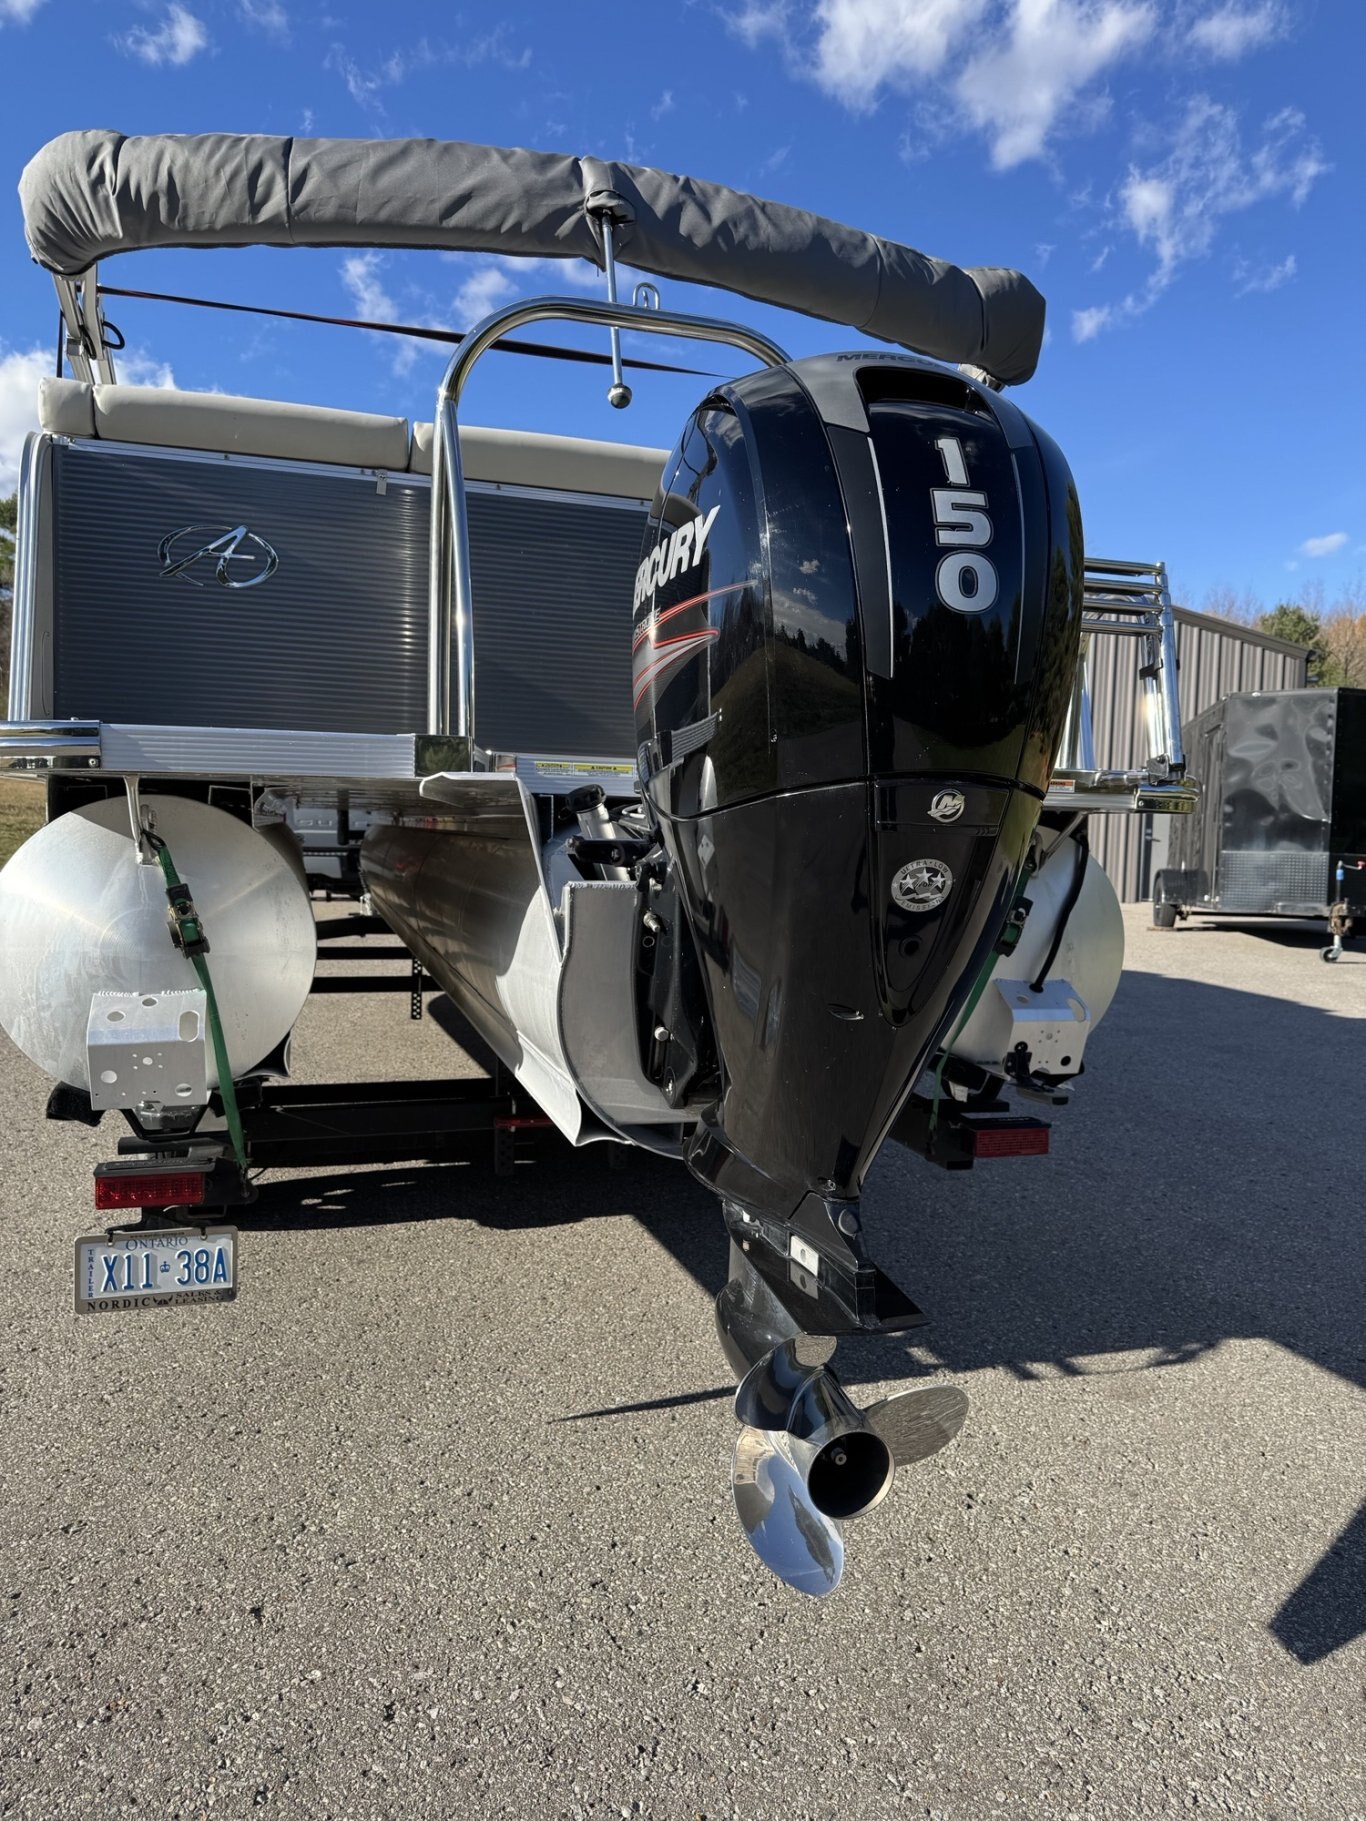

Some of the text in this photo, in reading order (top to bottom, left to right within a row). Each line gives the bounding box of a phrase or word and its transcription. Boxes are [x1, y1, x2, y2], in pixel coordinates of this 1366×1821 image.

[930, 437, 999, 614] 150
[632, 505, 720, 620] ERCURY
[125, 1237, 188, 1251] ONTARIO
[87, 1249, 95, 1299] TRAILER
[100, 1246, 228, 1293] X11 38A
[87, 1297, 151, 1312] NORDIC
[175, 1289, 211, 1299] SALES
